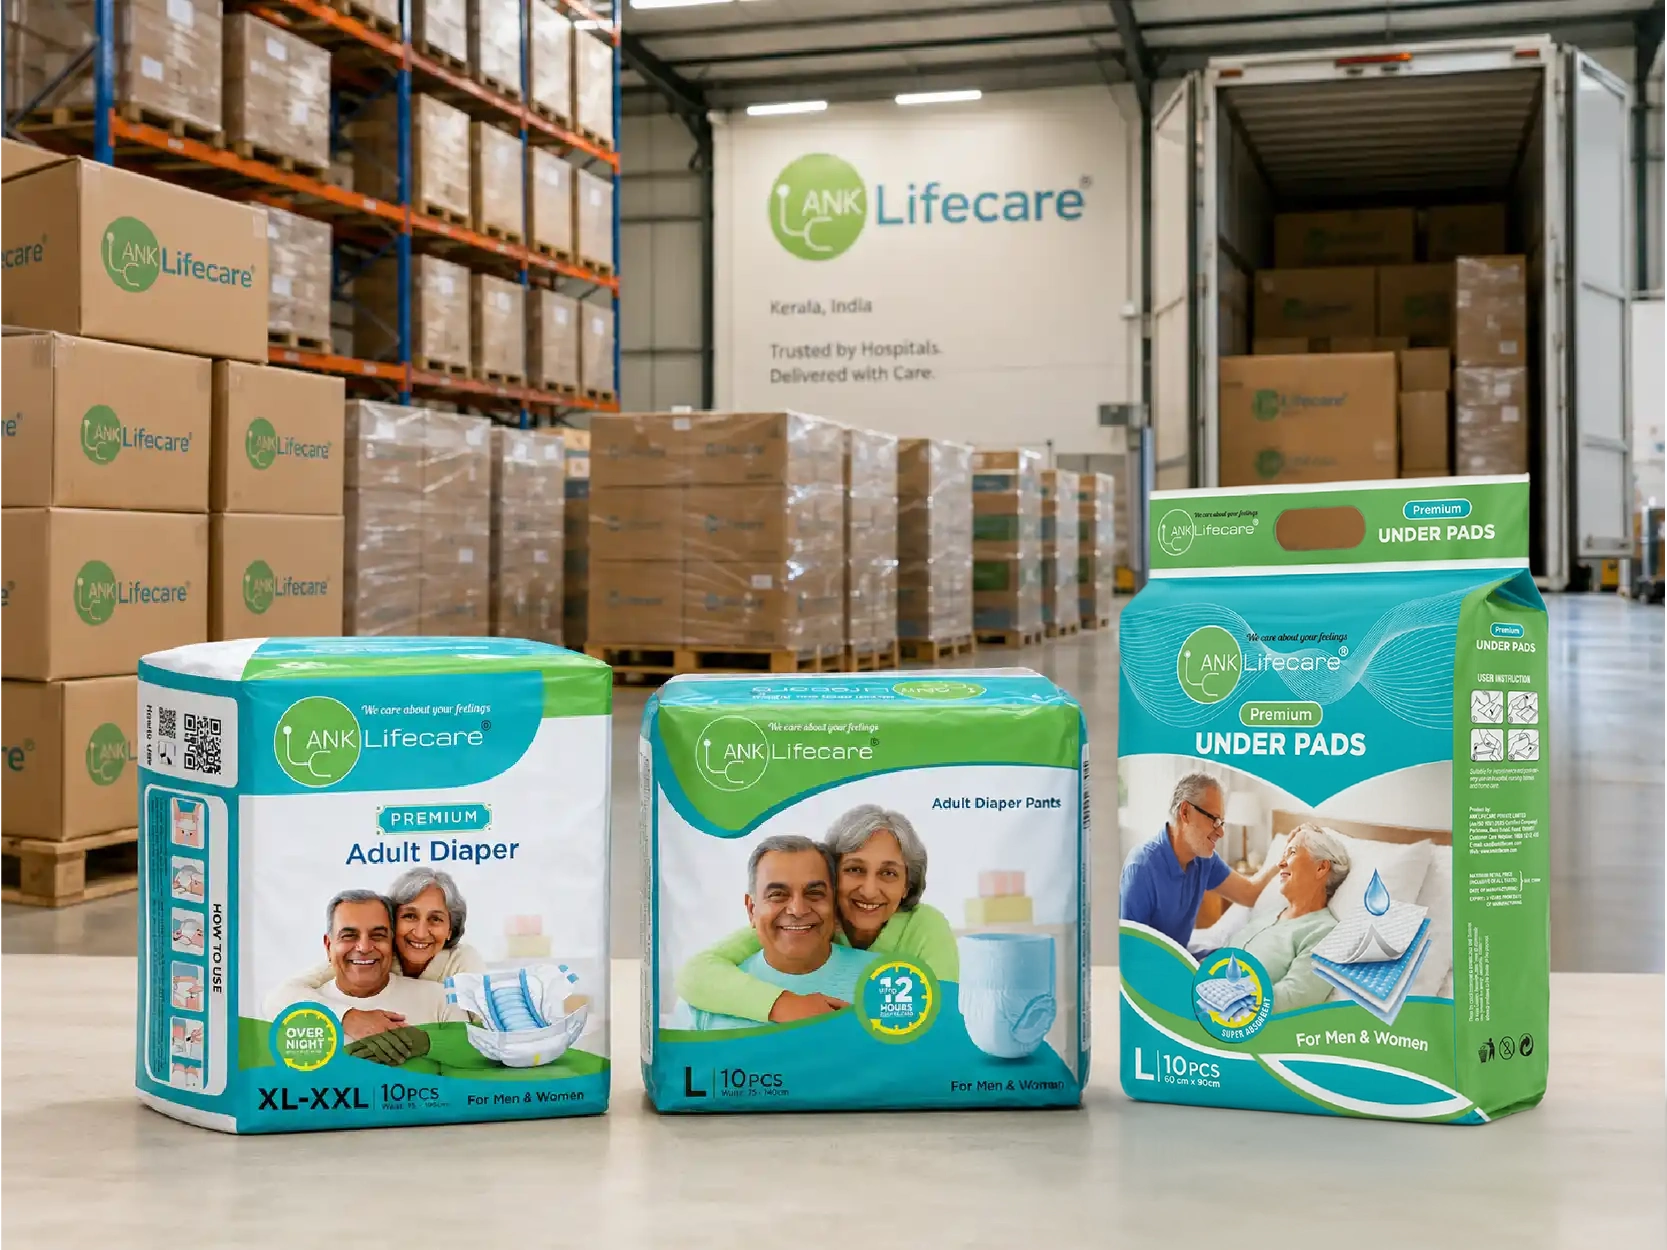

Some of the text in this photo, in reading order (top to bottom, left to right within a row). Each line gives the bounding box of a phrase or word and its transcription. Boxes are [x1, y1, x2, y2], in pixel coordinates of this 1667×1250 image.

[802, 183, 1085, 226] ANK Lifecare
[121, 240, 252, 288] ANK Lifecare
[770, 298, 872, 317] Kerala, India
[770, 340, 943, 361] Trusted by Hospitals.
[770, 365, 935, 384] Delivered with Care.
[94, 425, 190, 452] ANK Lifecare
[277, 440, 329, 460] Lifecare
[1413, 505, 1461, 515] Premium
[1171, 524, 1254, 536] ANK Lifecare
[1378, 524, 1496, 543] UNDER PADS
[89, 582, 187, 605] ANK Lifecare
[275, 577, 327, 598] Lifecare
[1246, 633, 1259, 642] We
[1278, 633, 1298, 641] about
[1300, 634, 1317, 643] your
[1317, 632, 1348, 643] feelings
[1495, 626, 1520, 635] Premium
[1476, 640, 1536, 652] UNDER PADS
[1200, 653, 1341, 671] ANK Lifecare
[1477, 673, 1531, 683] USER INSTRUCTION
[361, 703, 491, 716] We care about your feelings
[1250, 708, 1312, 721] Premium
[804, 722, 826, 731] about
[828, 724, 847, 734] your
[847, 722, 879, 734] feelings
[306, 728, 483, 749] ANK Lifecare
[1195, 732, 1367, 756] UNDER PADS
[724, 743, 873, 760] ANK Lifecare
[932, 797, 1062, 811] Adult Diaper Pants
[391, 810, 477, 826] PREMIUM
[346, 838, 519, 865] Adult Diaper
[213, 904, 222, 994] HOW TO USE
[880, 977, 912, 1002] 12
[881, 1004, 912, 1012] HOURS
[1221, 997, 1271, 1039] SUPER ABSORBENT
[286, 1027, 324, 1038] OVER
[1296, 1030, 1429, 1051] For Men & Women
[286, 1038, 325, 1050] NIGHT
[1135, 1047, 1154, 1080] L
[684, 1067, 707, 1097] L
[951, 1080, 1064, 1092] For Men & Women
[1164, 1075, 1175, 1083] 60
[1198, 1079, 1220, 1088] 90cm
[258, 1087, 369, 1110] XL-XXL
[468, 1091, 584, 1106] For Men & Women
